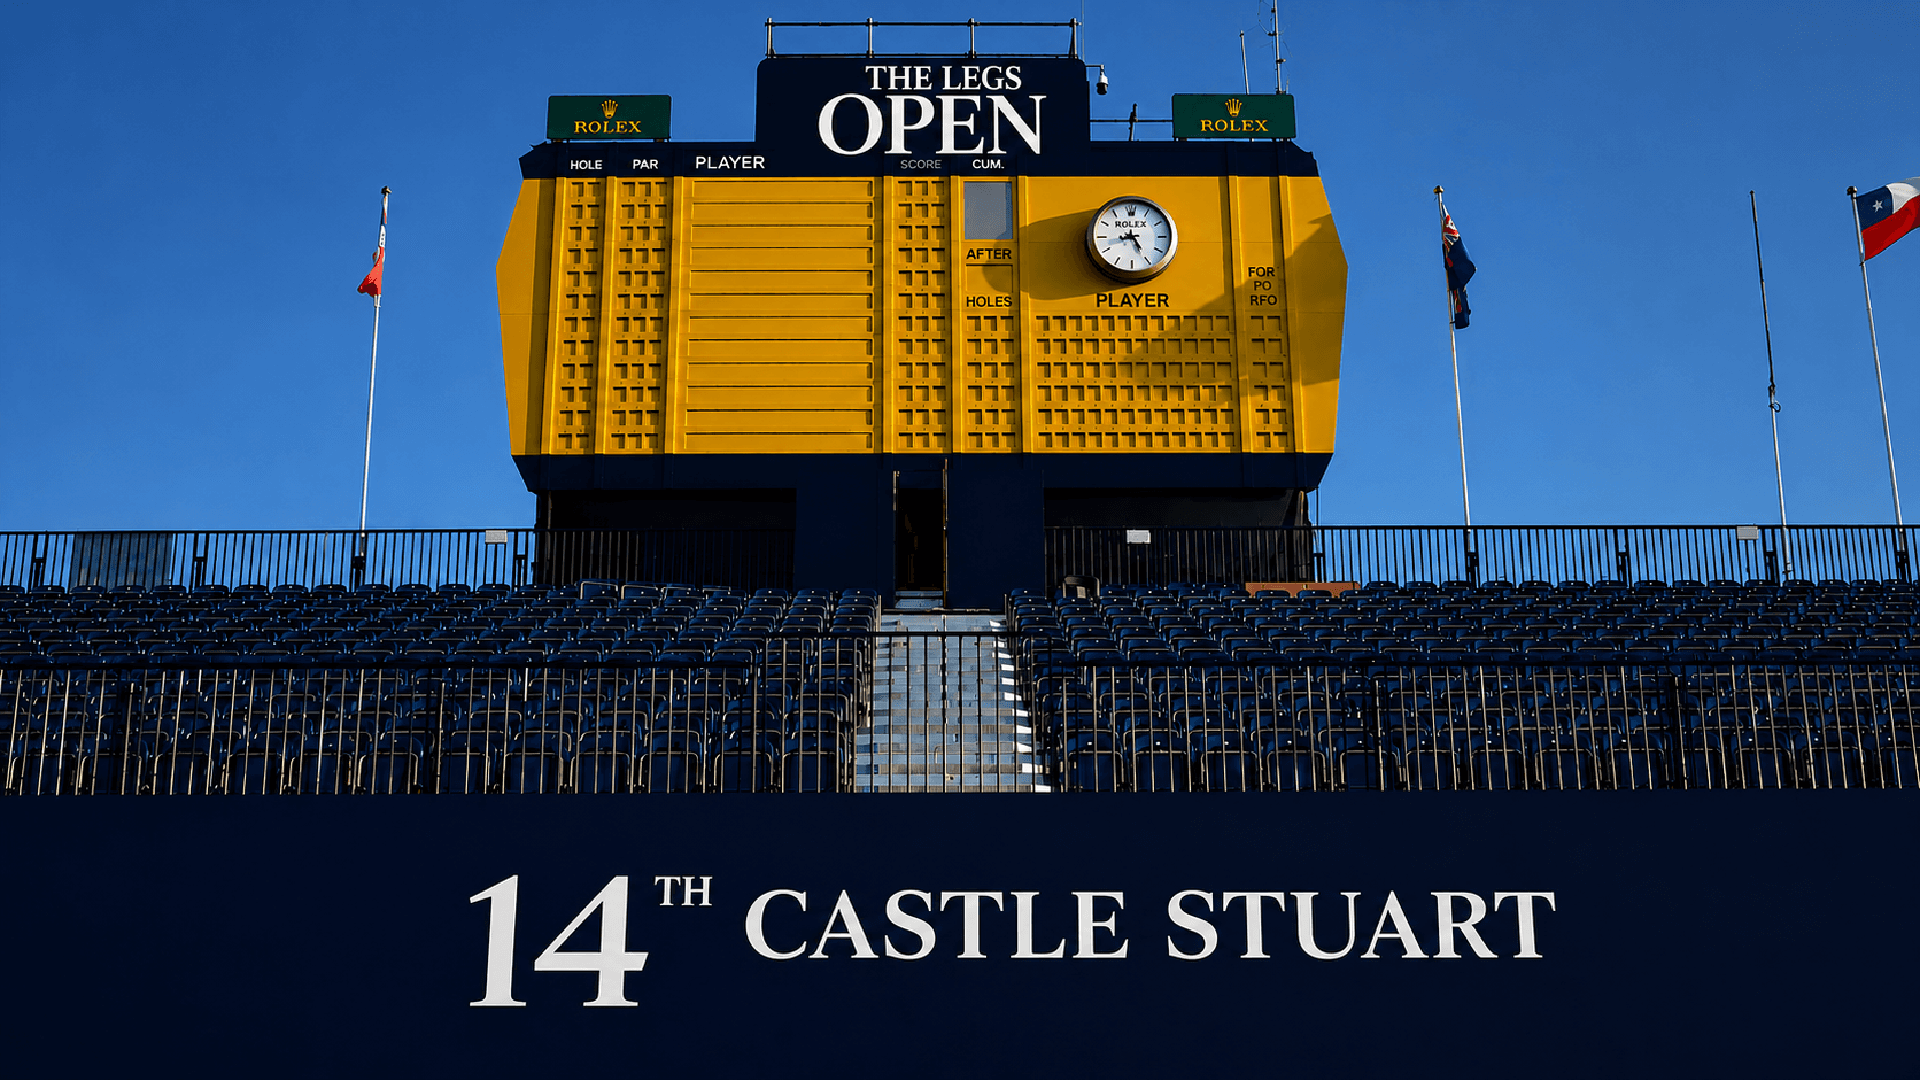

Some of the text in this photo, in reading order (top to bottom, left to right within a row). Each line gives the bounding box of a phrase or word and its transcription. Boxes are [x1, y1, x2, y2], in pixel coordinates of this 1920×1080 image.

[866, 65, 1022, 91] THE LEGS
[573, 120, 642, 134] ROLEX
[818, 93, 1047, 156] OPEN
[1200, 119, 1269, 132] ROLEX
[570, 159, 603, 170] HOLE
[632, 159, 659, 170] PAR
[695, 156, 766, 170] PLAYER
[900, 159, 943, 169] SCORE
[972, 159, 1005, 169] CUM.
[1114, 220, 1147, 229] ROLEX
[966, 247, 1012, 260] AFTER
[1247, 266, 1276, 278] FOR
[1253, 280, 1272, 291] PO
[966, 296, 1013, 308] HOLES
[1096, 293, 1170, 308] PLAYER
[1250, 295, 1278, 306] RFO
[745, 889, 1129, 960] CASTLE
[1166, 889, 1556, 960] STUART
